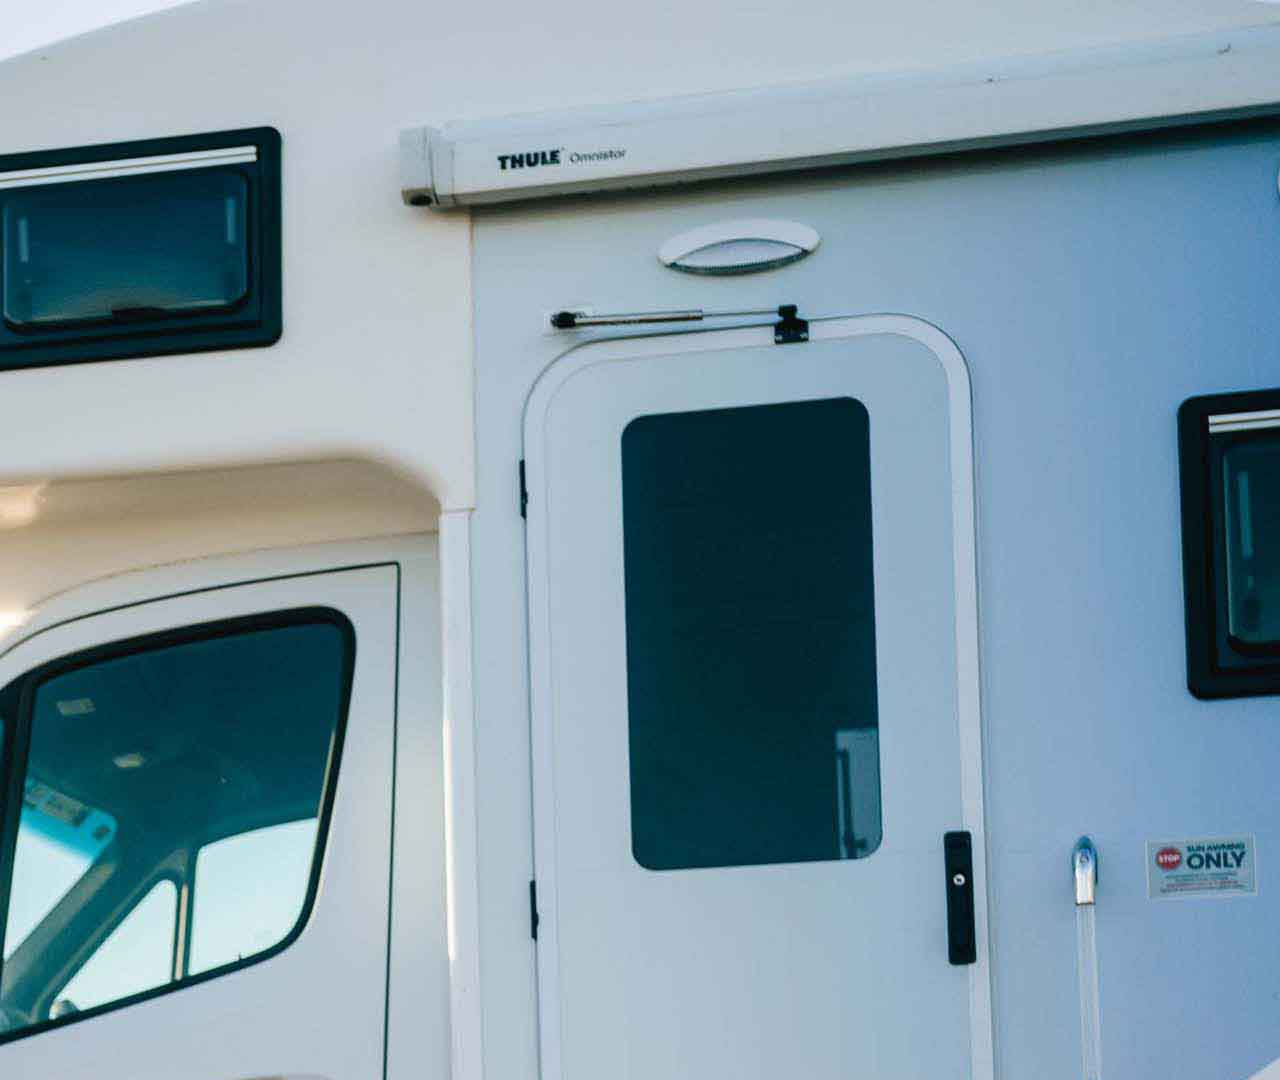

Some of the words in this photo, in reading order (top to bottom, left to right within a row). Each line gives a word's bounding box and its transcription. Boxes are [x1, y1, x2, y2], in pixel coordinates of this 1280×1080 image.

[497, 149, 561, 170] THULE
[1158, 853, 1181, 865] STOP
[1186, 851, 1246, 870] ONLY
